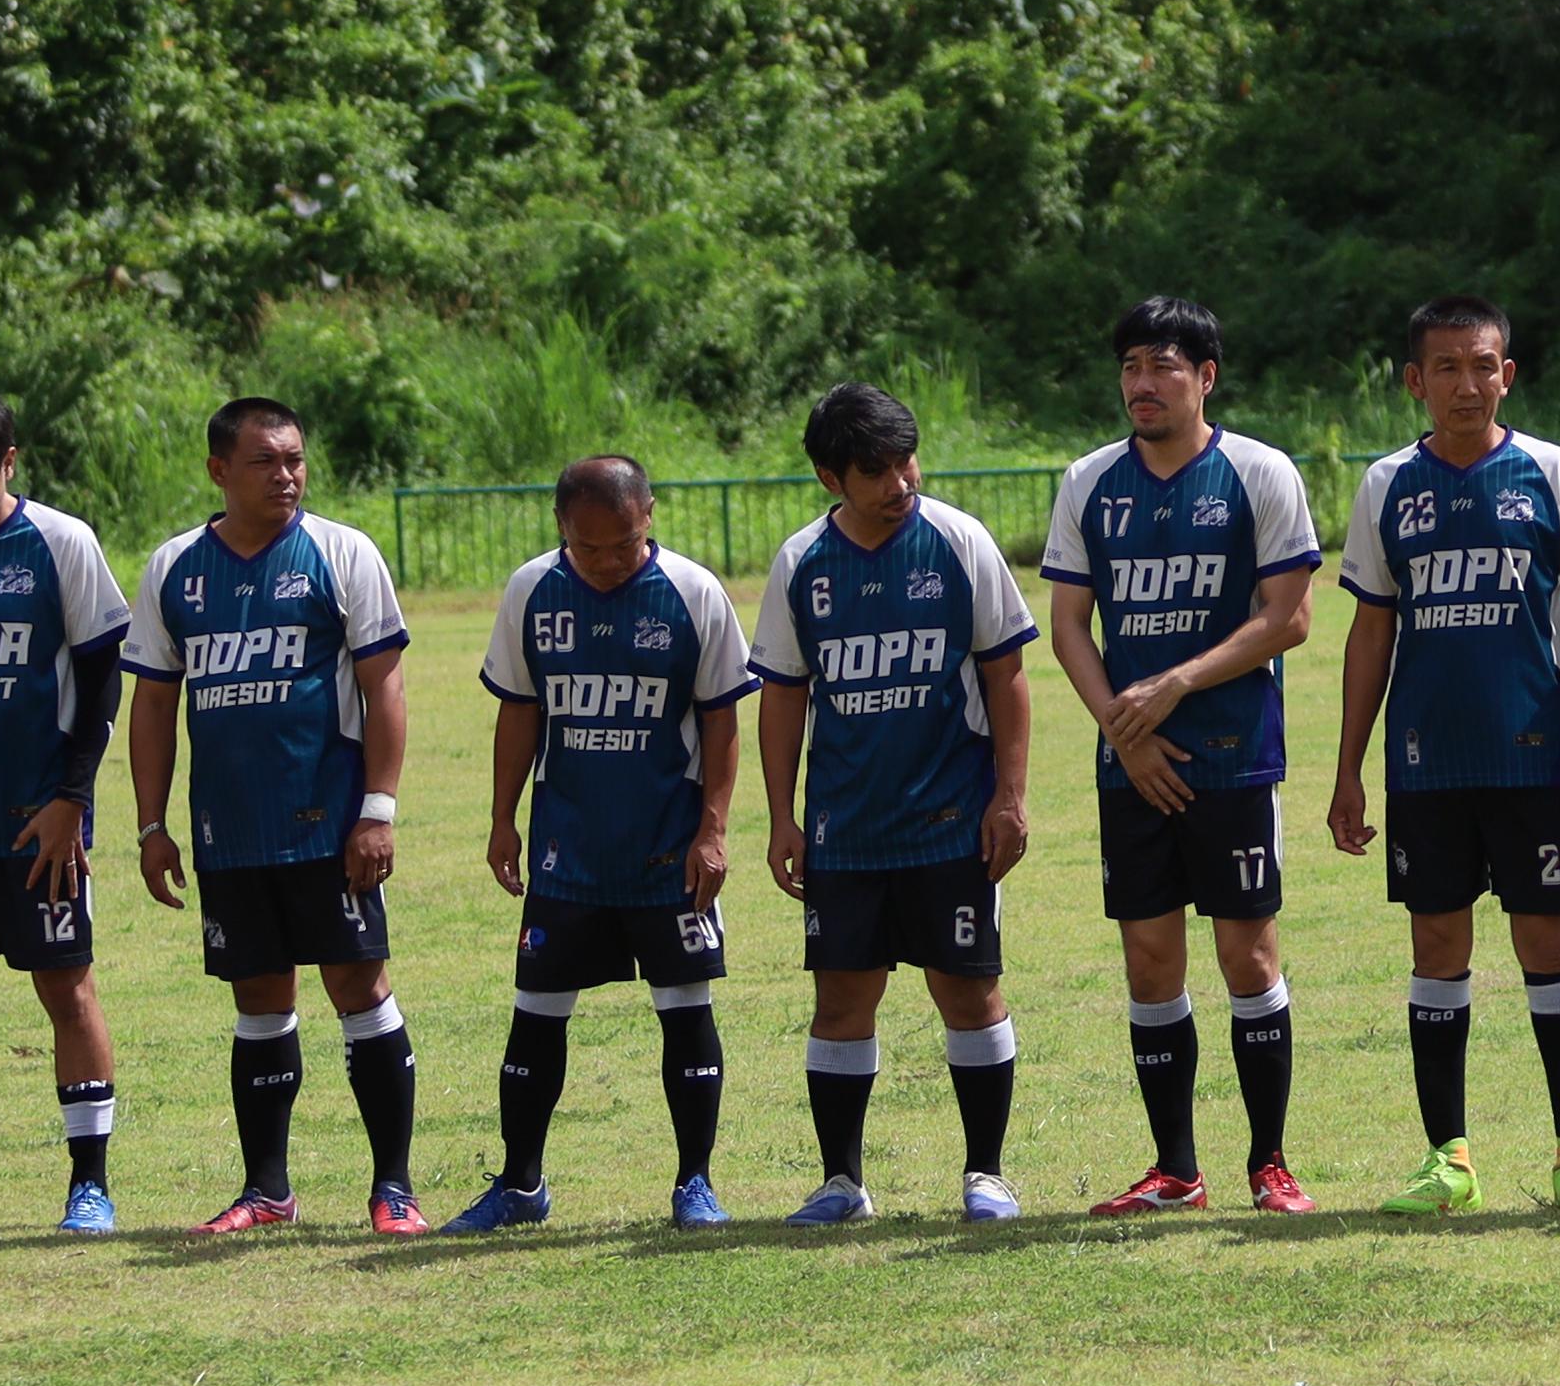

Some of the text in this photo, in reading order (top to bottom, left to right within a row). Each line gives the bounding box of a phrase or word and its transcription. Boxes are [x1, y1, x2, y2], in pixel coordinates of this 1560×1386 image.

[1100, 496, 1133, 538] 17
[1396, 489, 1436, 540] 23
[184, 575, 205, 613] 4
[1109, 554, 1227, 604] DOPA
[1409, 547, 1533, 601] DOPA
[811, 576, 832, 619] 6
[1414, 603, 1519, 631] MAESOT
[184, 625, 308, 678] DOPA
[533, 612, 576, 654] 50
[817, 628, 947, 683] DOPA
[195, 680, 293, 712] MAESOT
[544, 674, 669, 718] DOPA
[562, 727, 651, 752] MAESOT
[1231, 846, 1265, 891] 17
[37, 901, 76, 943] 12
[676, 912, 720, 953] 50
[954, 905, 976, 947] 6
[1246, 1029, 1280, 1042] EGO
[1417, 1010, 1454, 1021] EGO
[253, 1072, 293, 1086] EGO
[503, 1064, 528, 1075] GO
[685, 1066, 718, 1077] EGO
[1137, 1053, 1172, 1064] EGO
